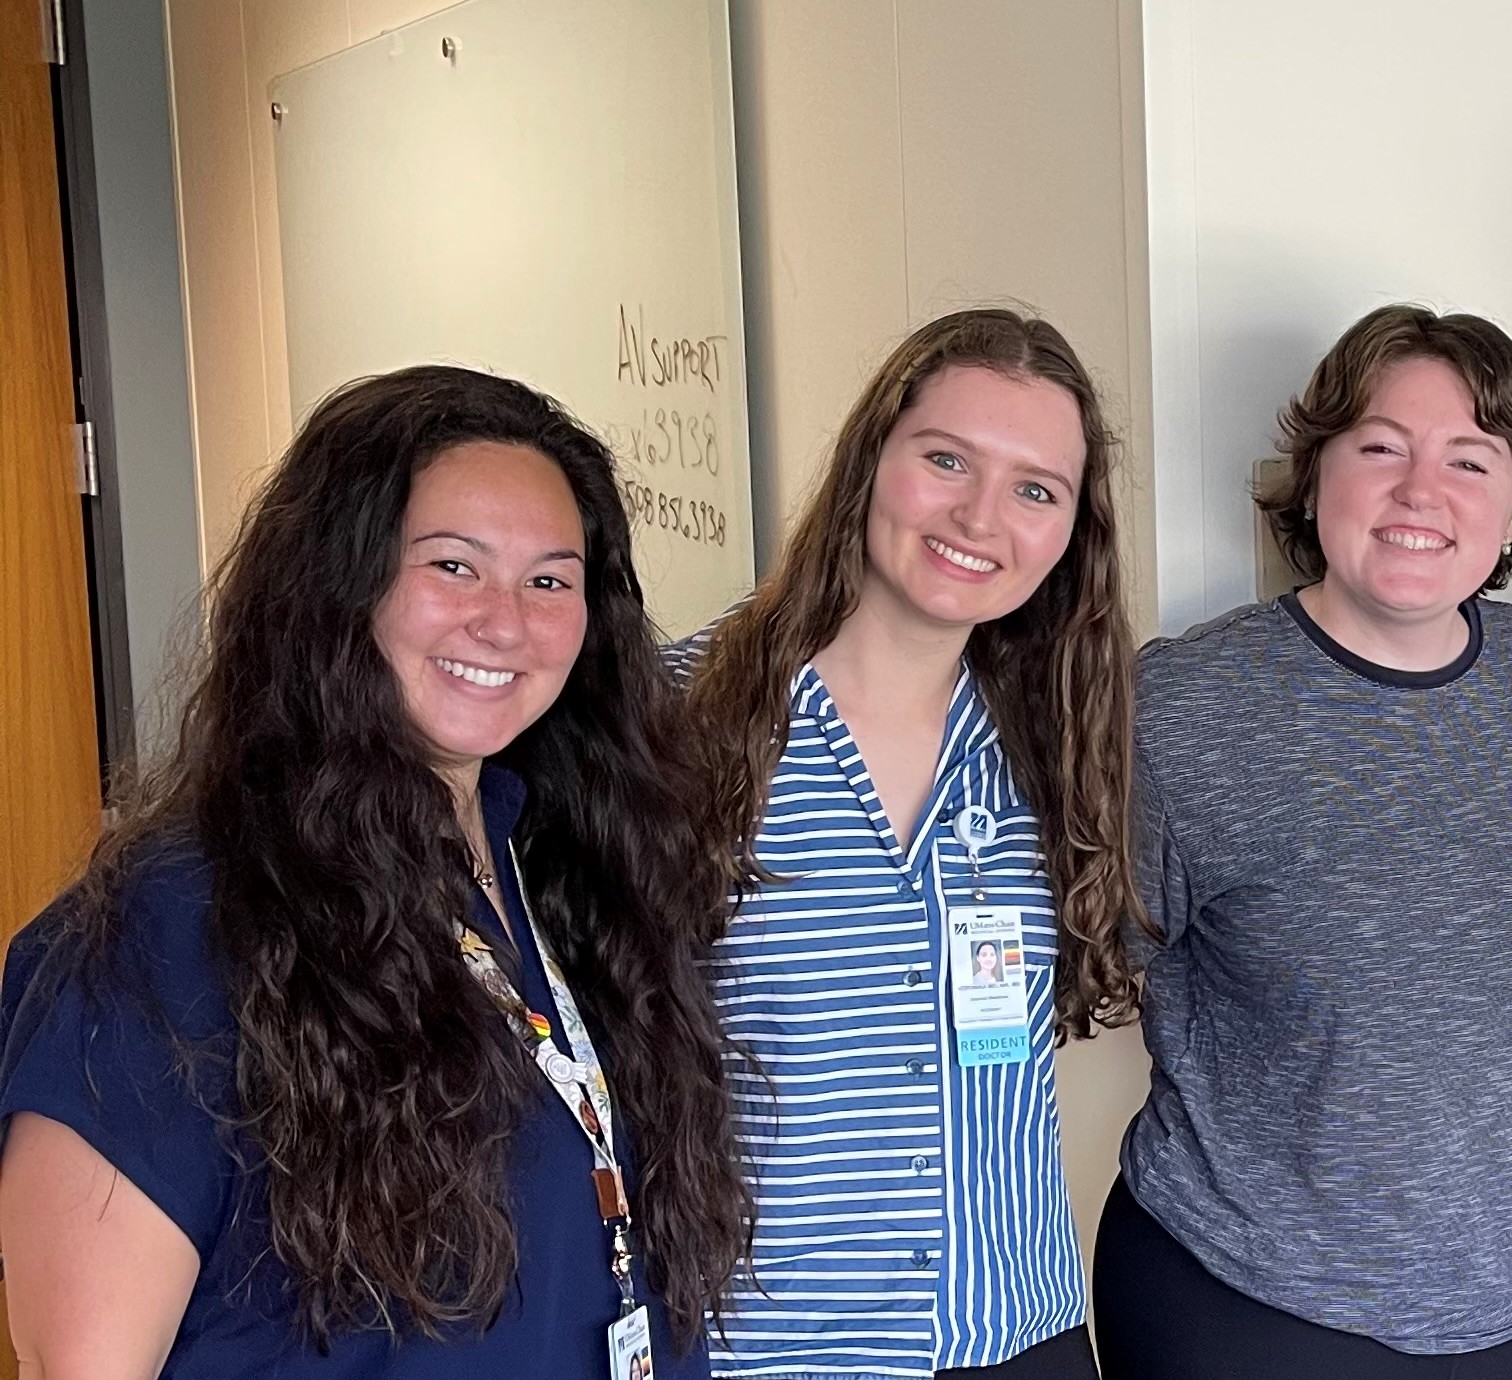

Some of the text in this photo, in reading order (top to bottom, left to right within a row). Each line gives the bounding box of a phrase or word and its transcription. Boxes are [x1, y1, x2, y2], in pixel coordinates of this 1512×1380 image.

[617, 303, 728, 393] AV SUPPORT
[960, 1035, 1027, 1052] RESIDENT
[978, 1051, 1012, 1061] DOCTOR
